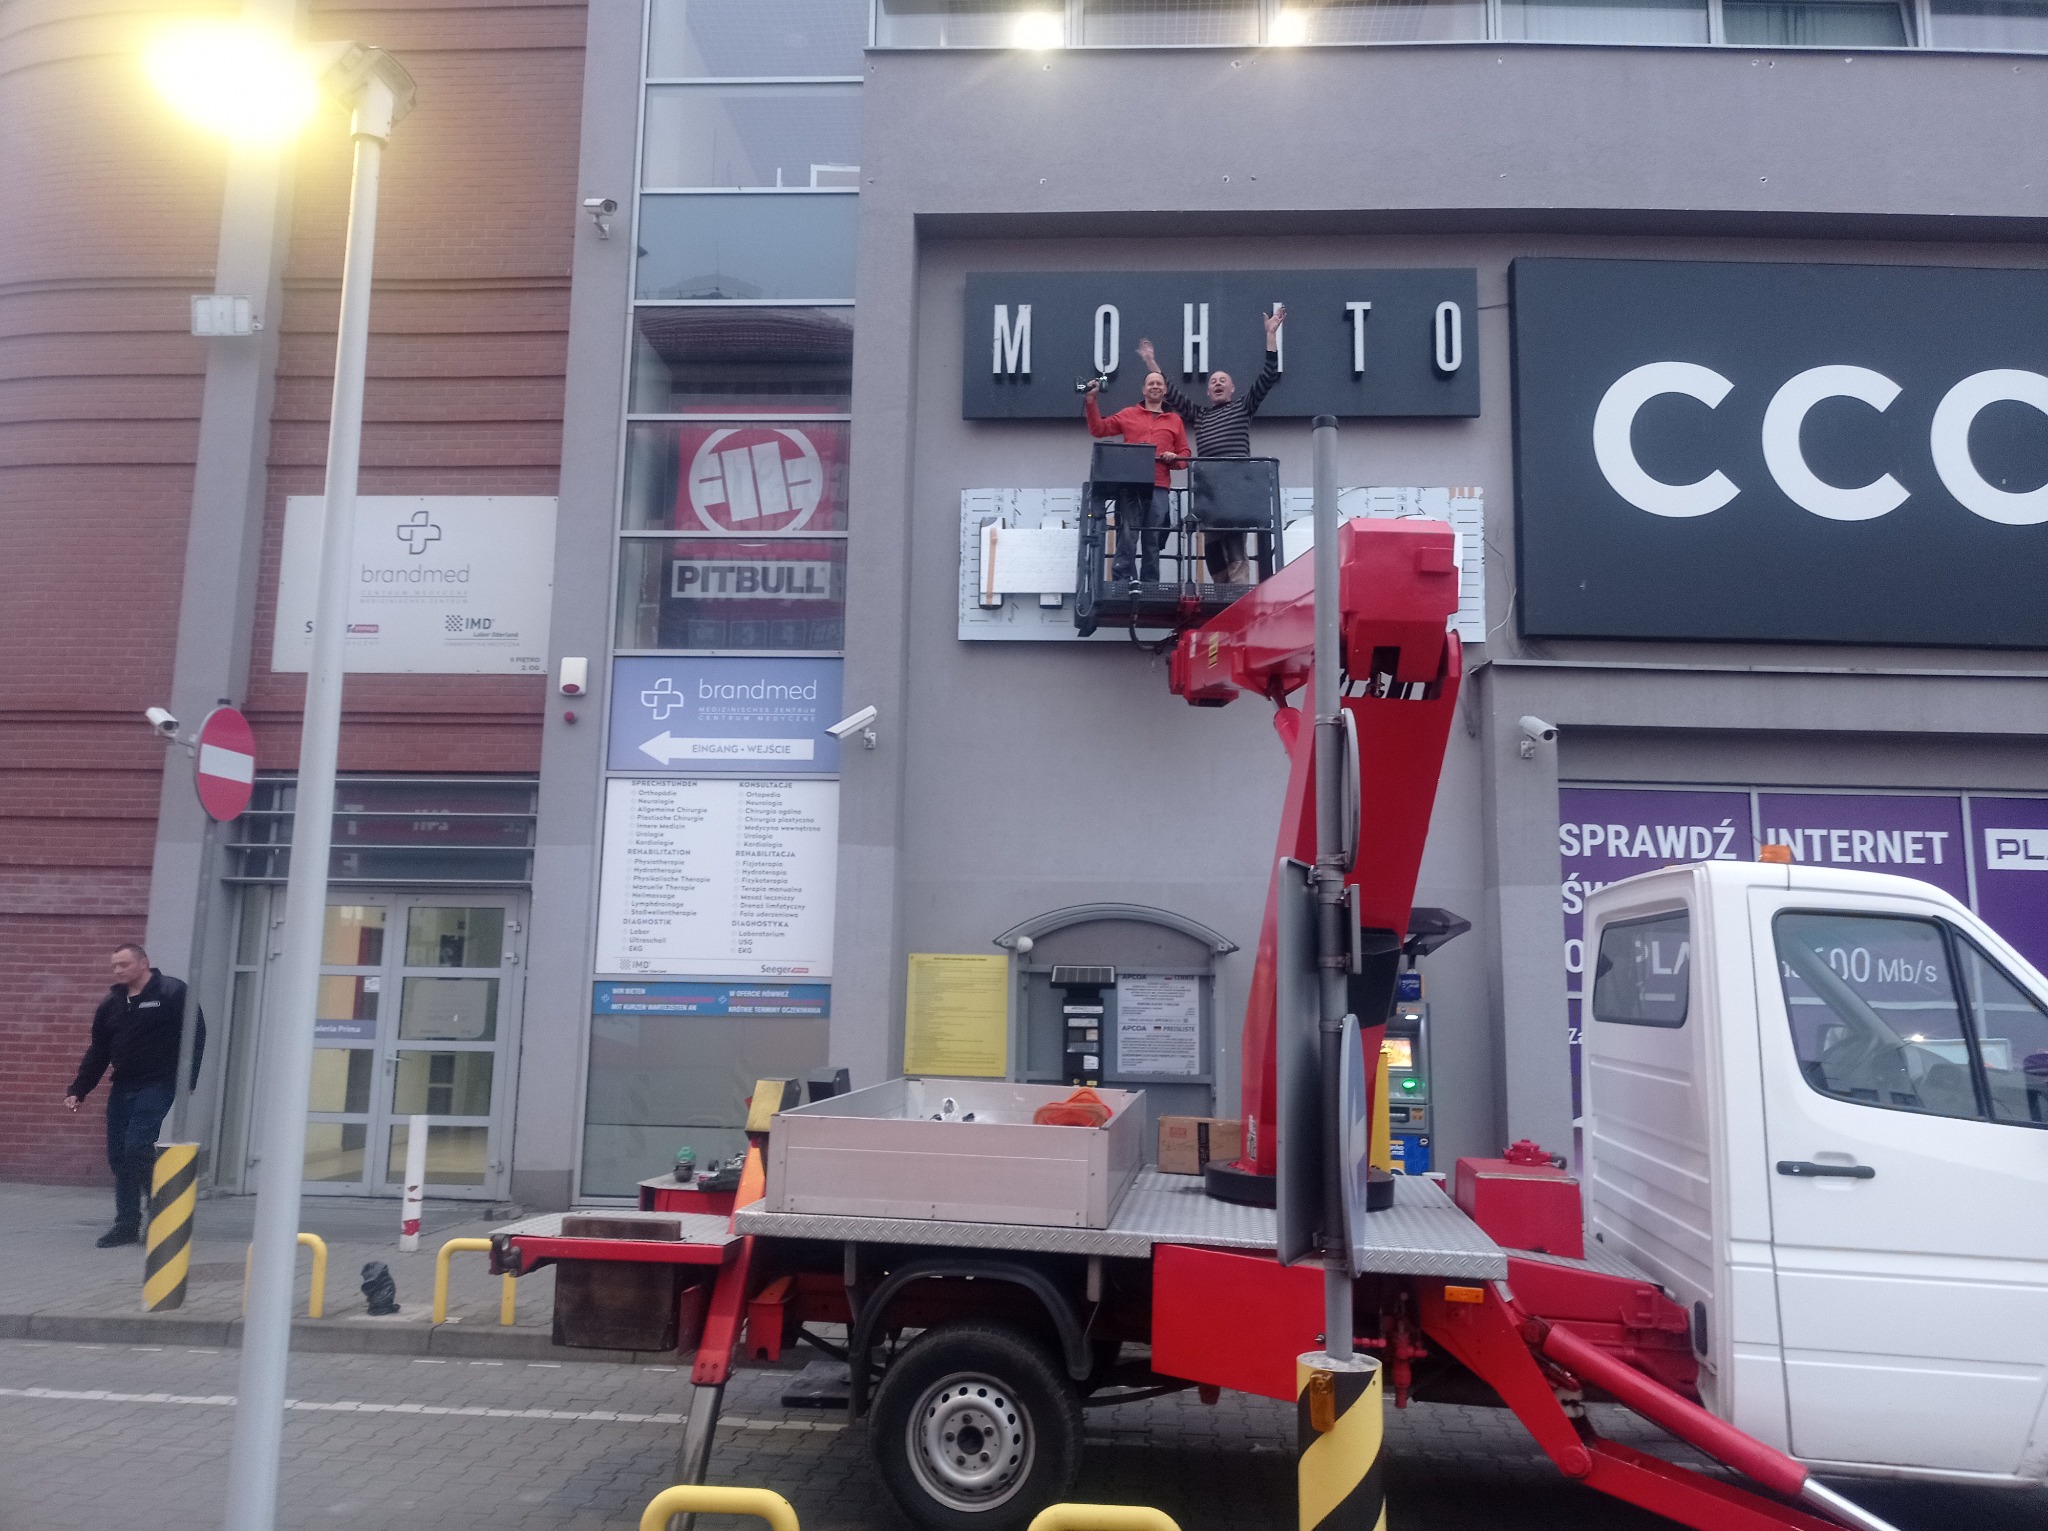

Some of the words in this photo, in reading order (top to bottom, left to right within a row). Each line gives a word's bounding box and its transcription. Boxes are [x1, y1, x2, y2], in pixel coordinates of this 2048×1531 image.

[993, 300, 1463, 375] MOHITO
[1593, 361, 2048, 525] CCC
[361, 564, 470, 583] brandmed
[676, 565, 825, 594] PITBULL
[465, 618, 492, 630] IMD
[698, 678, 817, 700] brandmed
[698, 706, 770, 714] MEDIZINISCHES
[757, 715, 816, 723] MEDYCZNE
[692, 744, 739, 754] EINGANG
[748, 743, 791, 755] WEJŚCIE
[1558, 818, 1738, 860] SPRAWDŹ
[1766, 828, 1949, 865] INTERNET
[1996, 838, 2048, 861] PL
[761, 965, 791, 975] Seeger
[1814, 946, 1871, 983] 00
[1877, 958, 1938, 984] Mb/s
[314, 1024, 337, 1032] aleria
